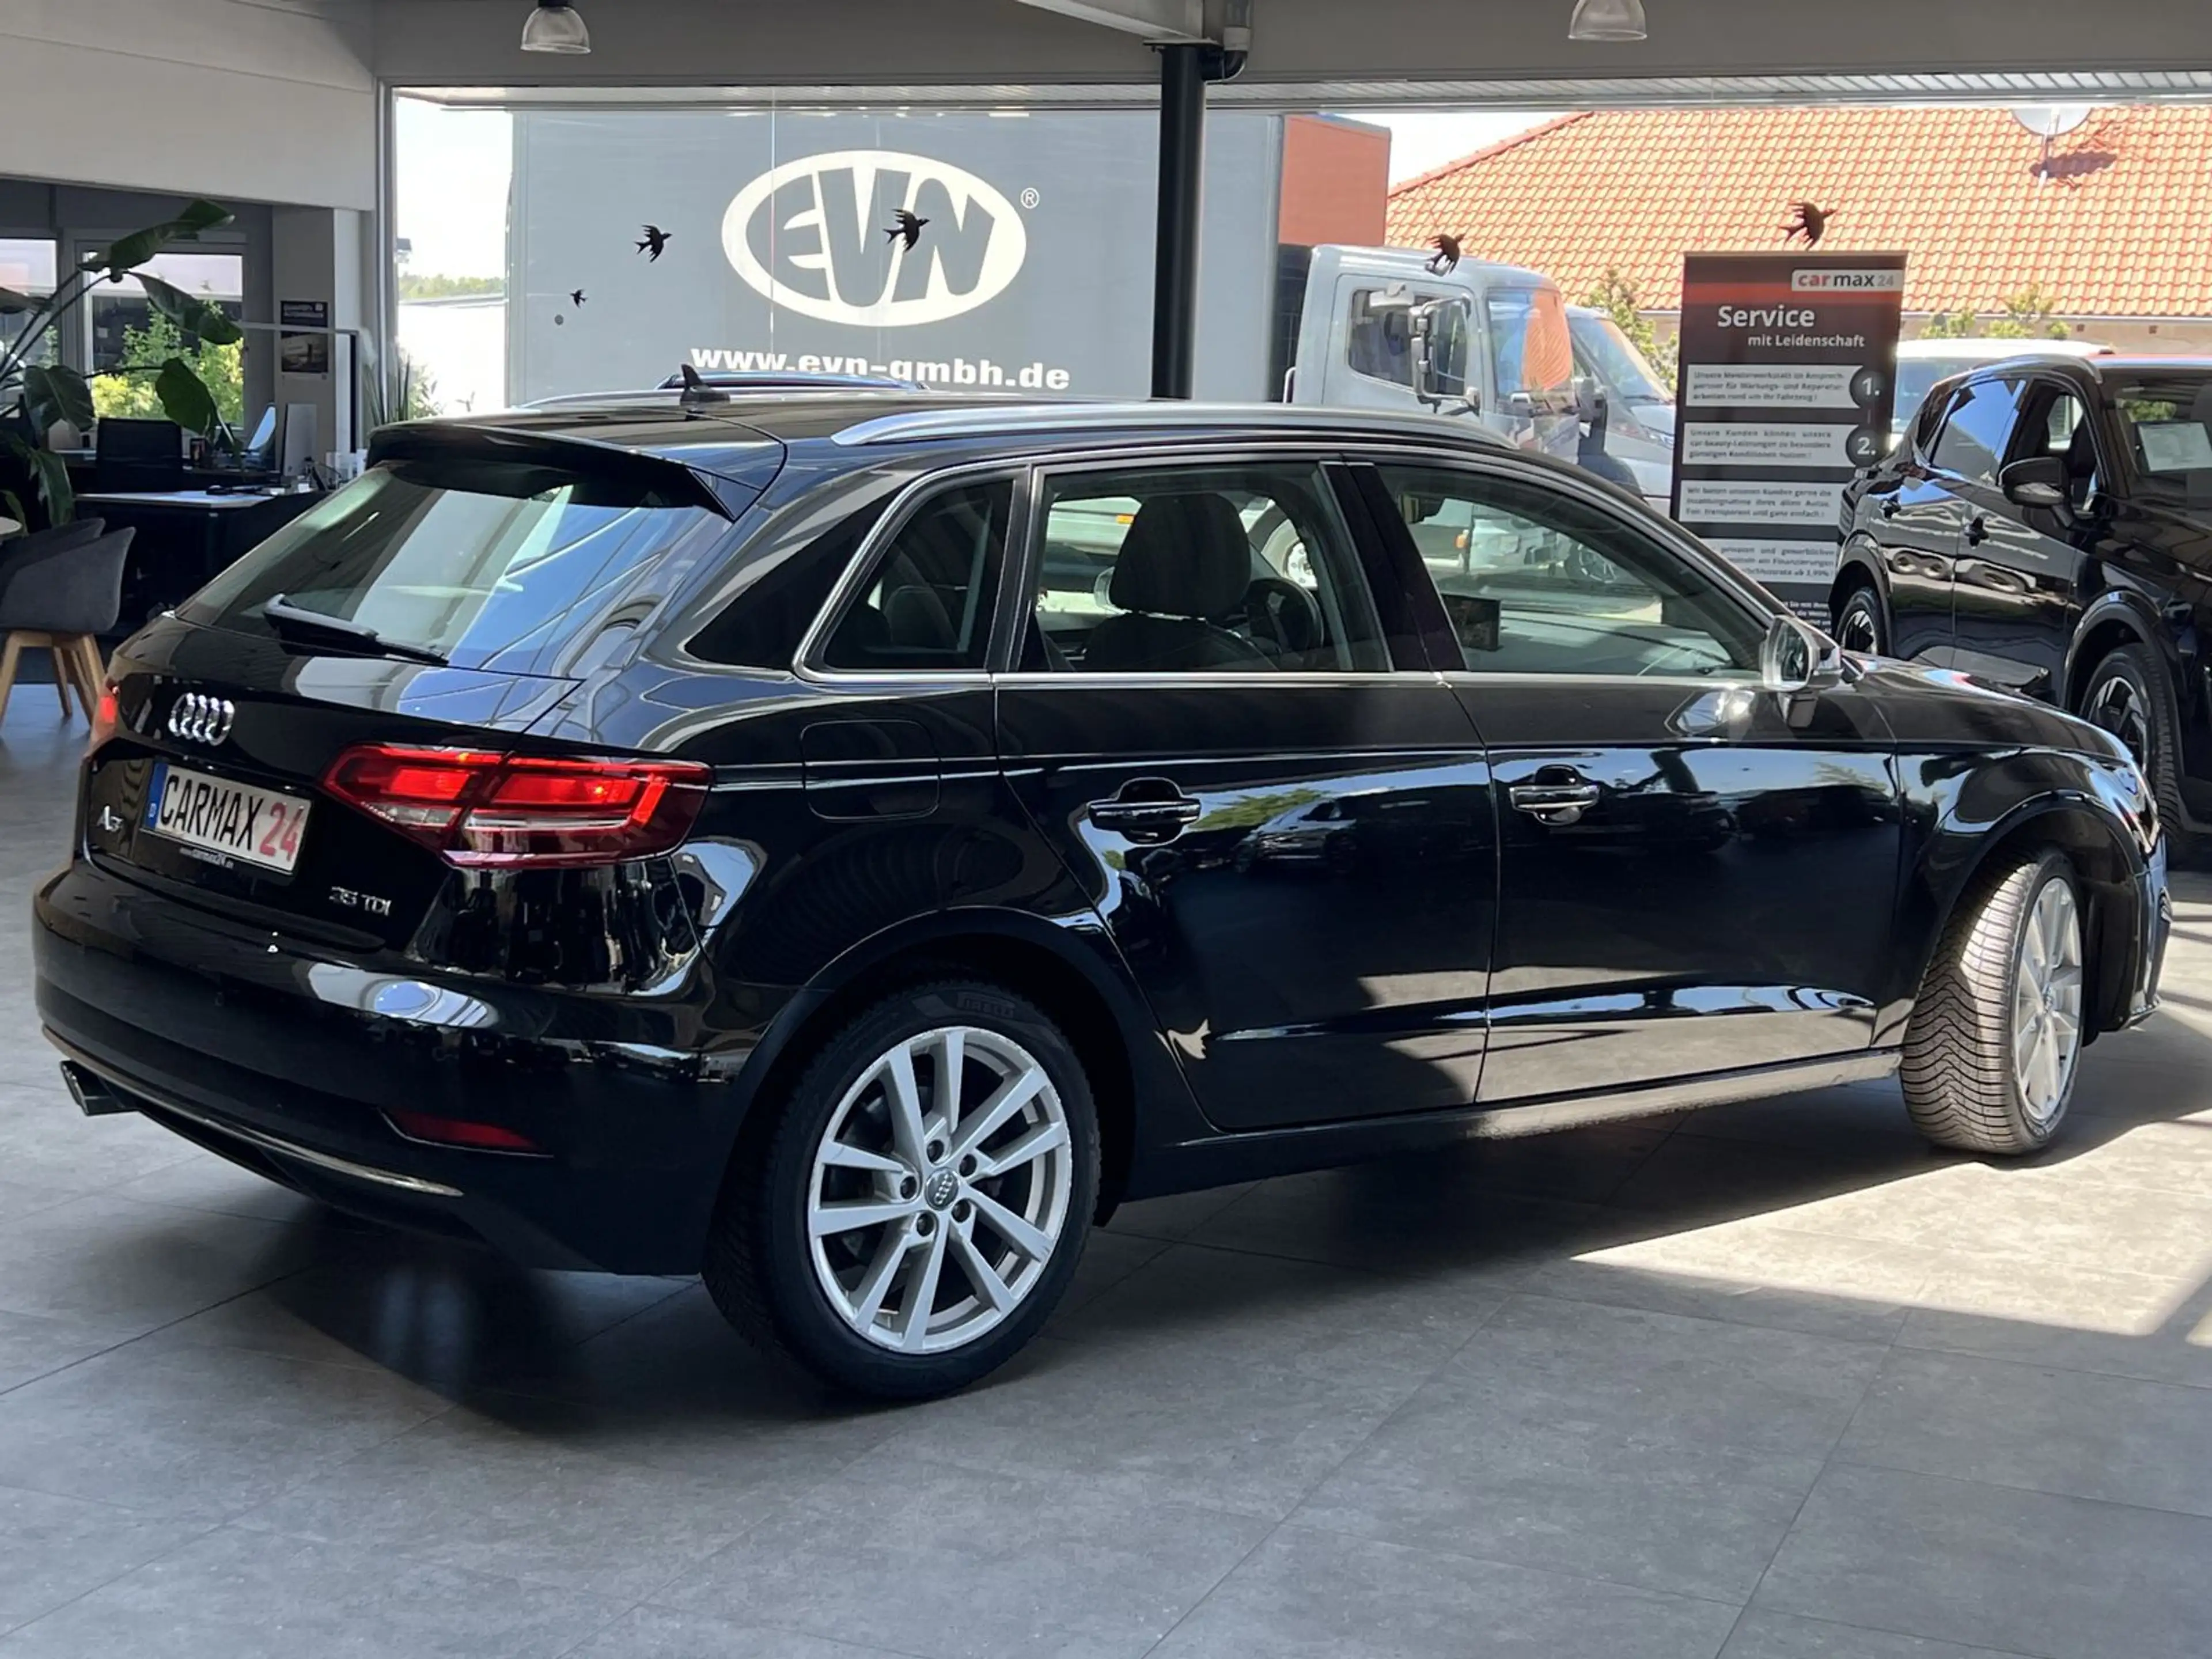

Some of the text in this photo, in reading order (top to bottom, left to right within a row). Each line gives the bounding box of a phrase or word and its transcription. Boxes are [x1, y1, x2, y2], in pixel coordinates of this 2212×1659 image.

[746, 166, 995, 308] EVN
[1717, 304, 1816, 328] Service
[1748, 334, 1866, 347] mit Leidenschaft
[690, 348, 1070, 390] www.evn-gmbh.de
[1862, 377, 1880, 396] 1.
[1857, 436, 1877, 456] 2.
[361, 893, 392, 916] TDI
